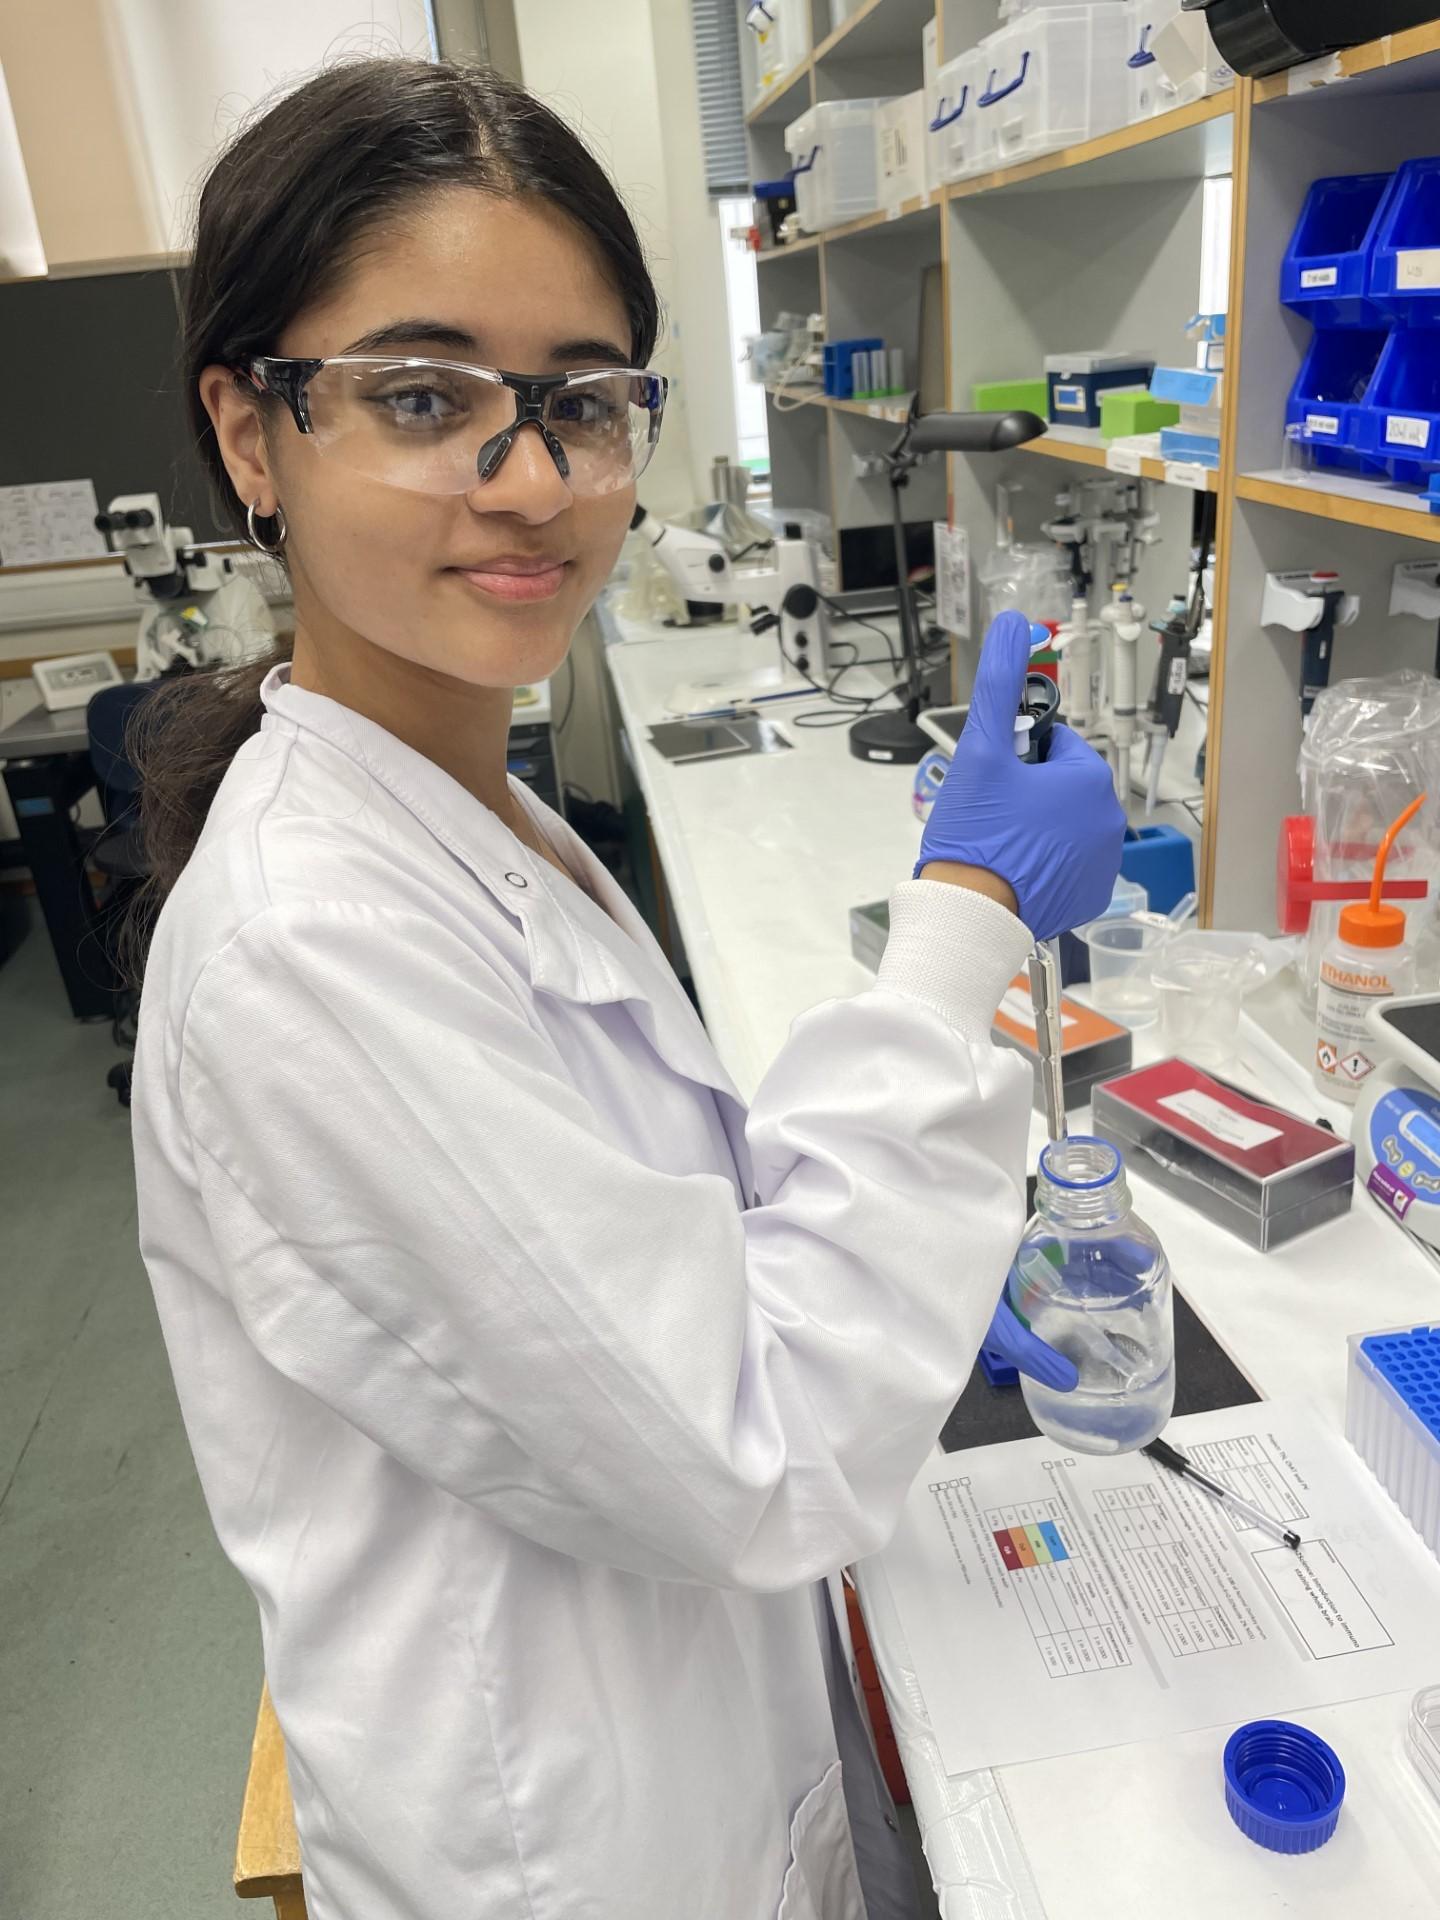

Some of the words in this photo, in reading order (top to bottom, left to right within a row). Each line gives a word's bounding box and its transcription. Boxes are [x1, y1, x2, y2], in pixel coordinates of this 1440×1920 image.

[1292, 1567, 1313, 1591] staining
[1307, 1590, 1325, 1609] whole
[1319, 1609, 1336, 1627] brain.
[1310, 1577, 1340, 1614] Introduction
[1334, 1613, 1345, 1622] to
[1339, 1621, 1362, 1648] immuno
[1104, 1626, 1126, 1663] Concentration
